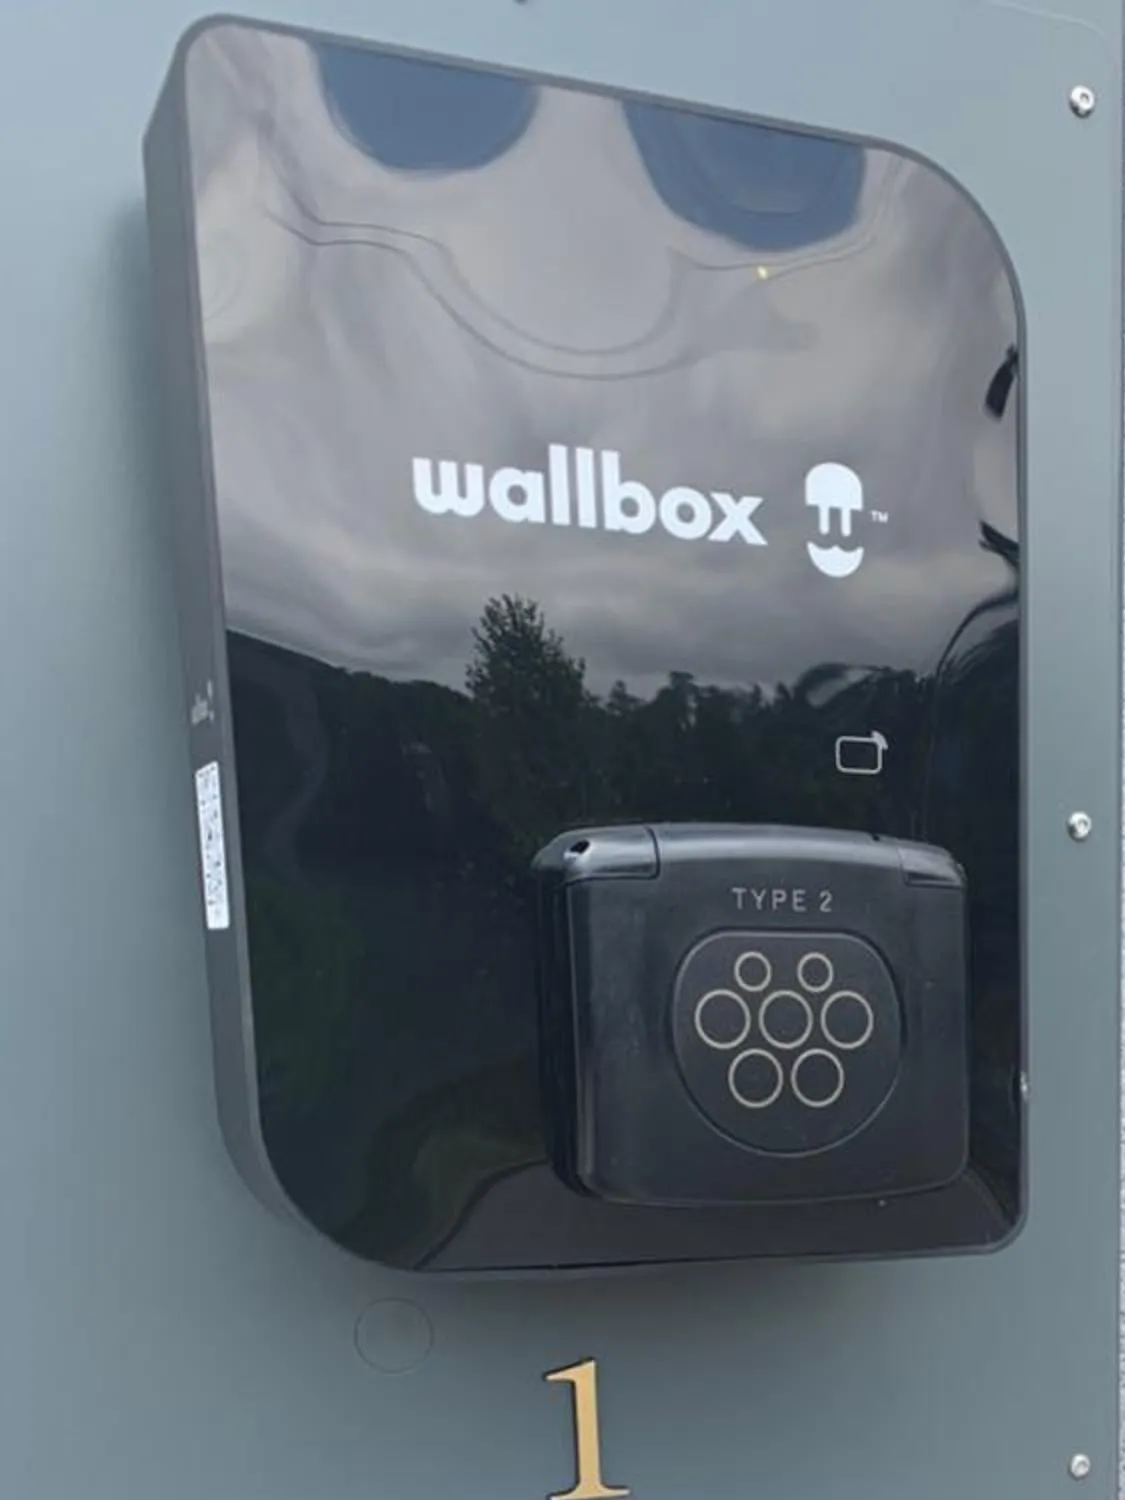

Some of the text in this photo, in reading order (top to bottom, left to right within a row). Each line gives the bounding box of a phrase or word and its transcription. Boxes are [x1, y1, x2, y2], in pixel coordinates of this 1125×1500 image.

[412, 443, 768, 546] wallbox
[731, 887, 832, 912] TYPE 2
